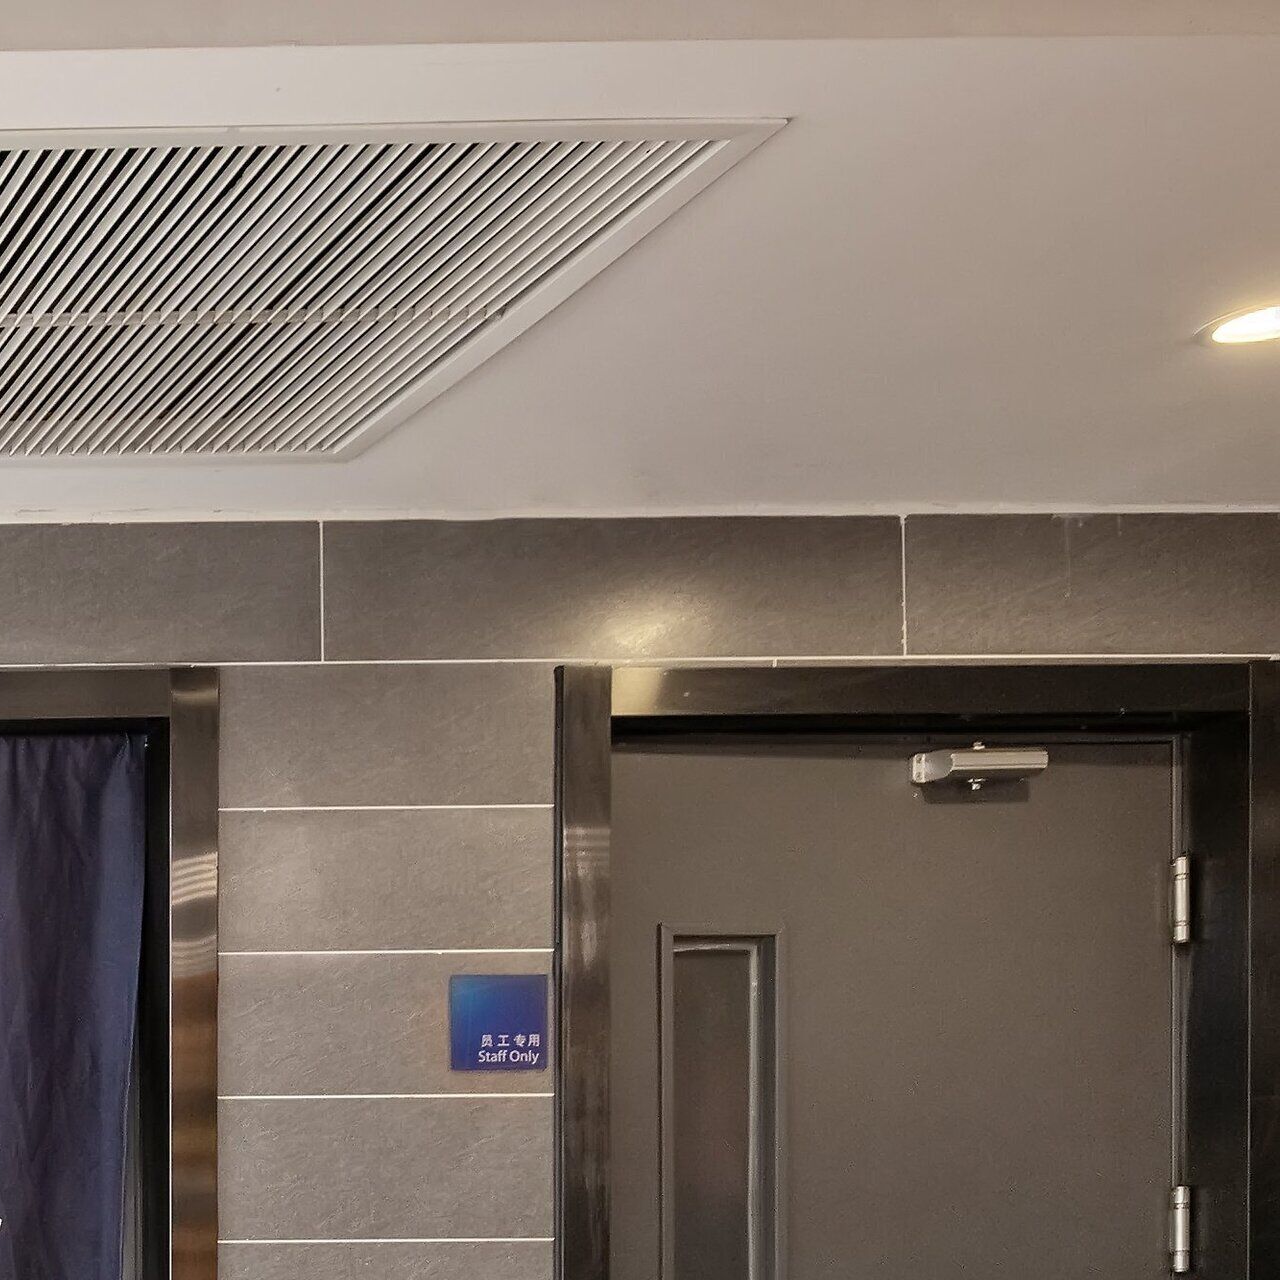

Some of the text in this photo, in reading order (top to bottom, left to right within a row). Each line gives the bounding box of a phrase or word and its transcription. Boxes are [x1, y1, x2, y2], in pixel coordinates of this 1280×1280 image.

[481, 1034, 540, 1047] 员工专用
[478, 1050, 539, 1064] Staff Only
